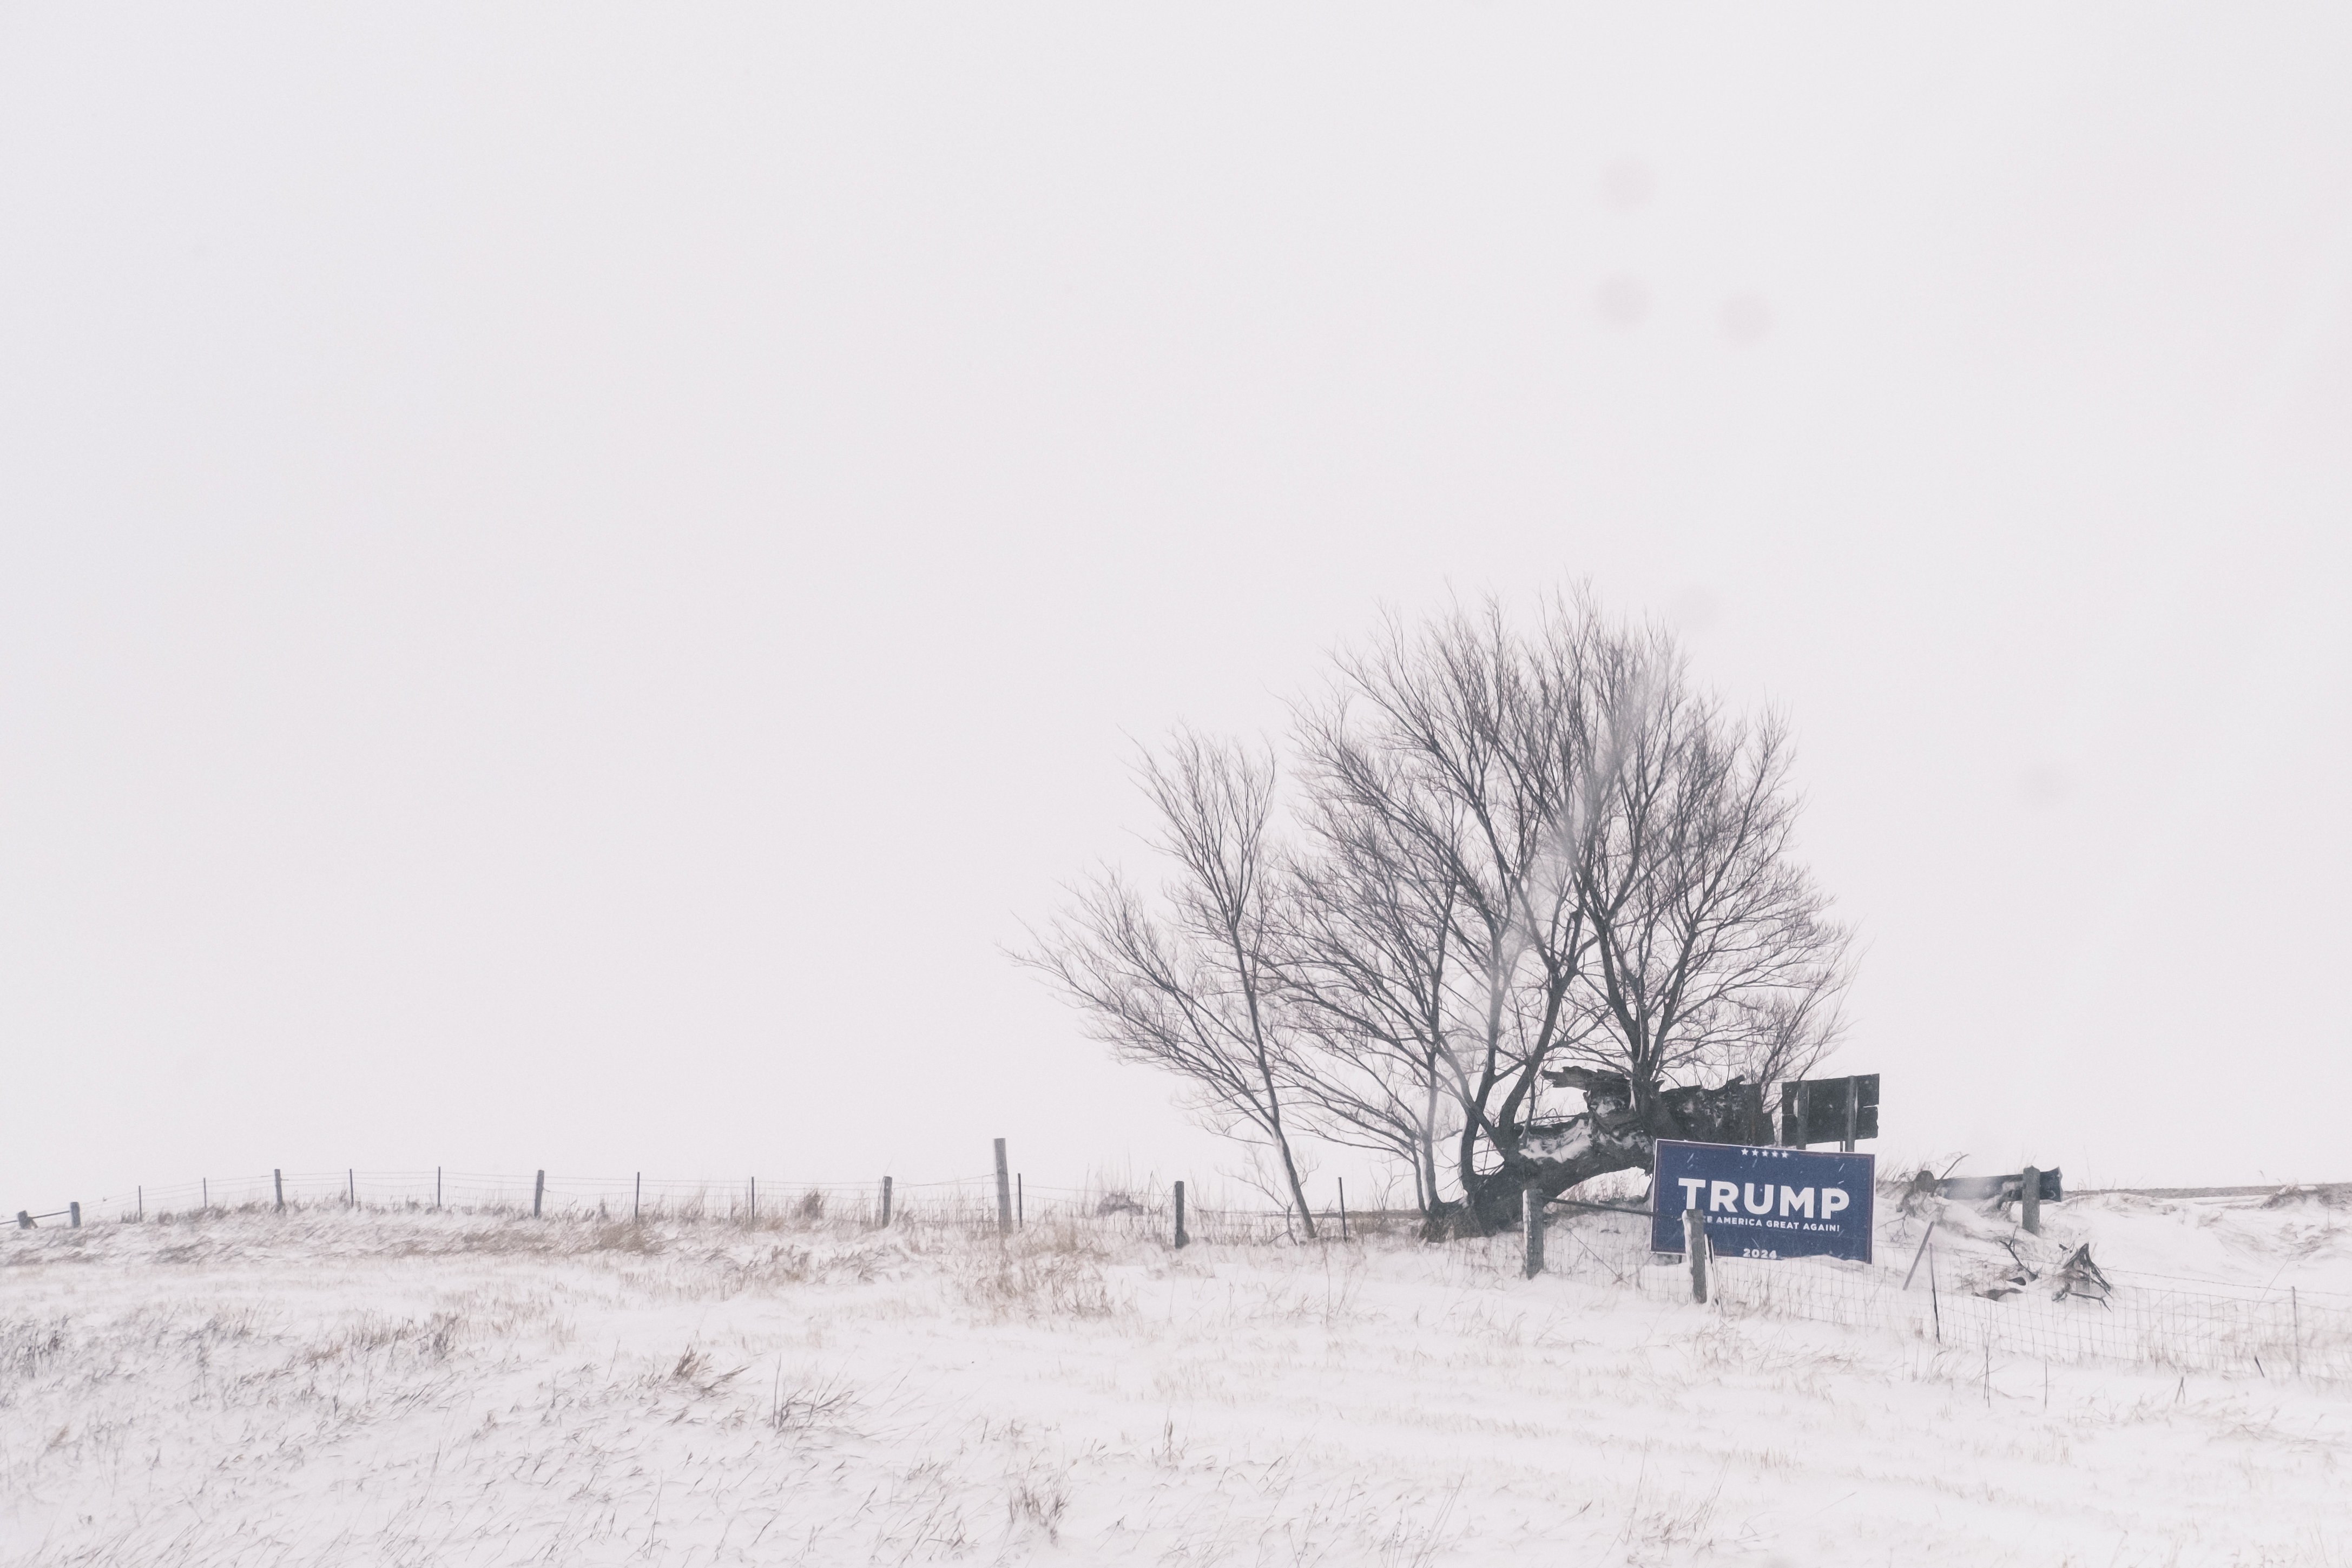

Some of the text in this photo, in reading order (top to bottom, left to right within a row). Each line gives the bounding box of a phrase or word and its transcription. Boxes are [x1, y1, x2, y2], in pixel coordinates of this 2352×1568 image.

[1678, 1178, 1849, 1219] TRUMP
[1716, 1216, 1762, 1226] AMERICA
[1766, 1220, 1799, 1229] GREAT
[1803, 1223, 1840, 1231] AGAIN!
[1743, 1248, 1777, 1259] 2024
